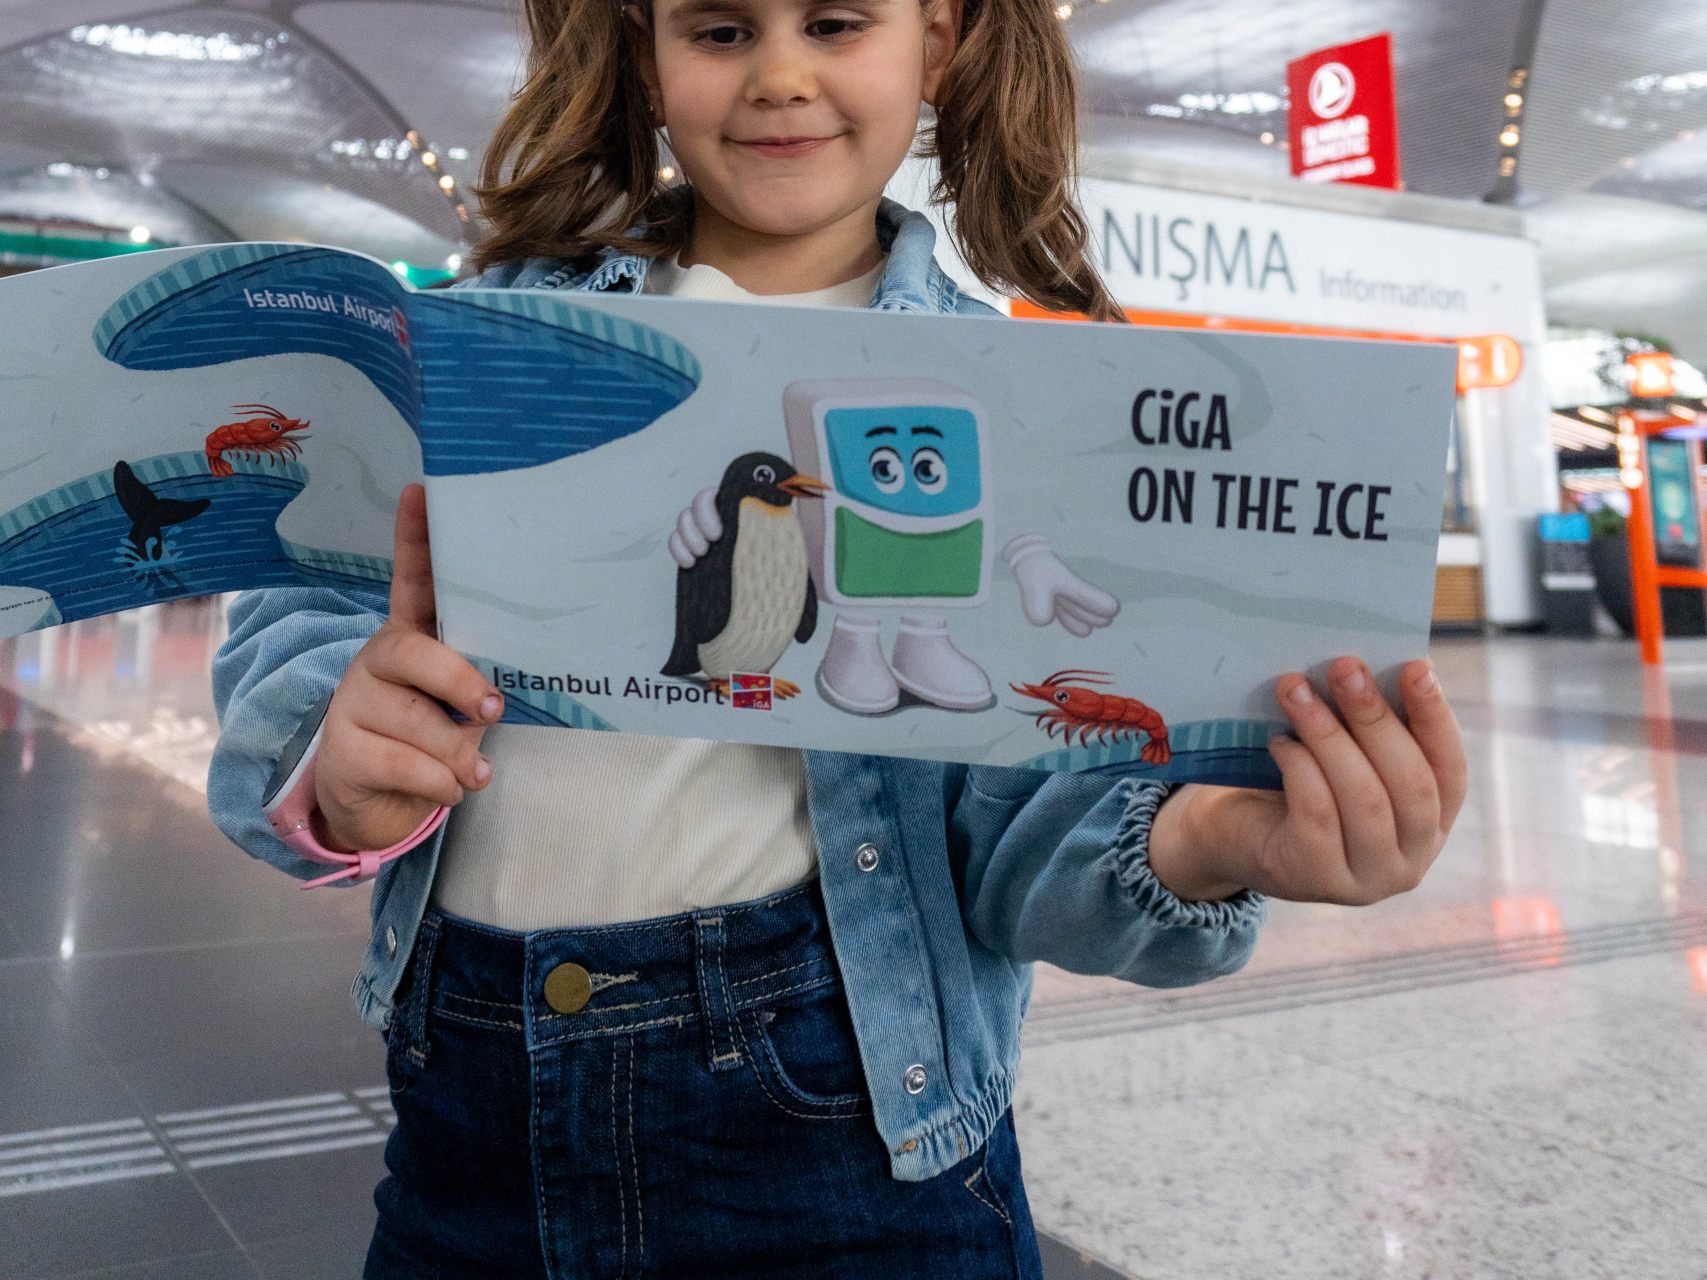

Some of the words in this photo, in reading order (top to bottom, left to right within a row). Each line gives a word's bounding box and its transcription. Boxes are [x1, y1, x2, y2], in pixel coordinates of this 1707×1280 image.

[1304, 135, 1368, 165] DOMESTIC
[1103, 208, 1297, 301] NIŞMA
[1319, 267, 1467, 312] Information
[243, 288, 338, 314] Istanbul
[1128, 466, 1195, 524] ON
[1212, 473, 1299, 534] THE
[1312, 480, 1391, 541] ICE
[493, 666, 612, 696] Istanbul
[623, 676, 725, 705] Airport
